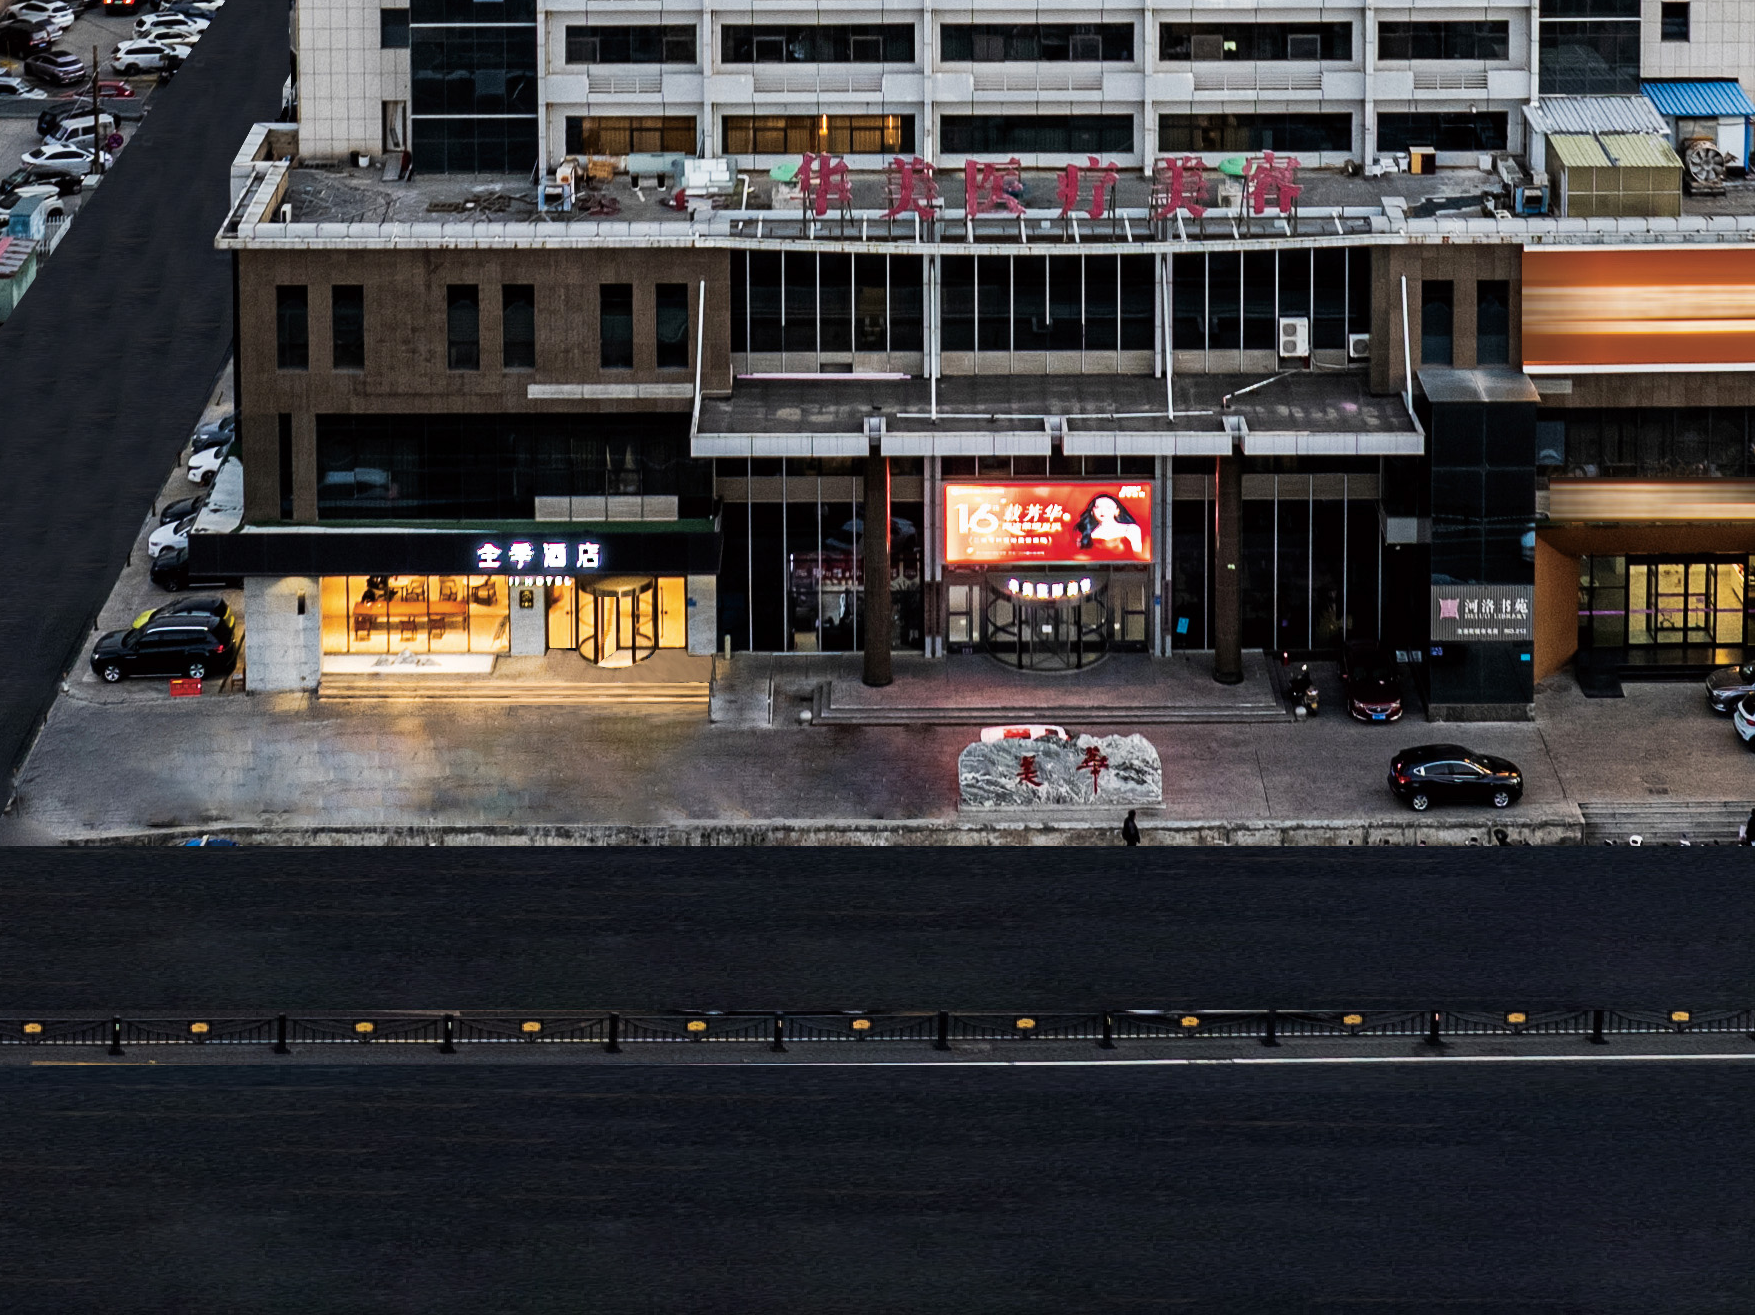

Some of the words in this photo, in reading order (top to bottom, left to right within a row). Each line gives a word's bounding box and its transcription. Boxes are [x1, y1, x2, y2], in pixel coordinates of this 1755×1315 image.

[794, 149, 1302, 220] 华美医疗美容
[477, 542, 601, 569] 全季酒店
